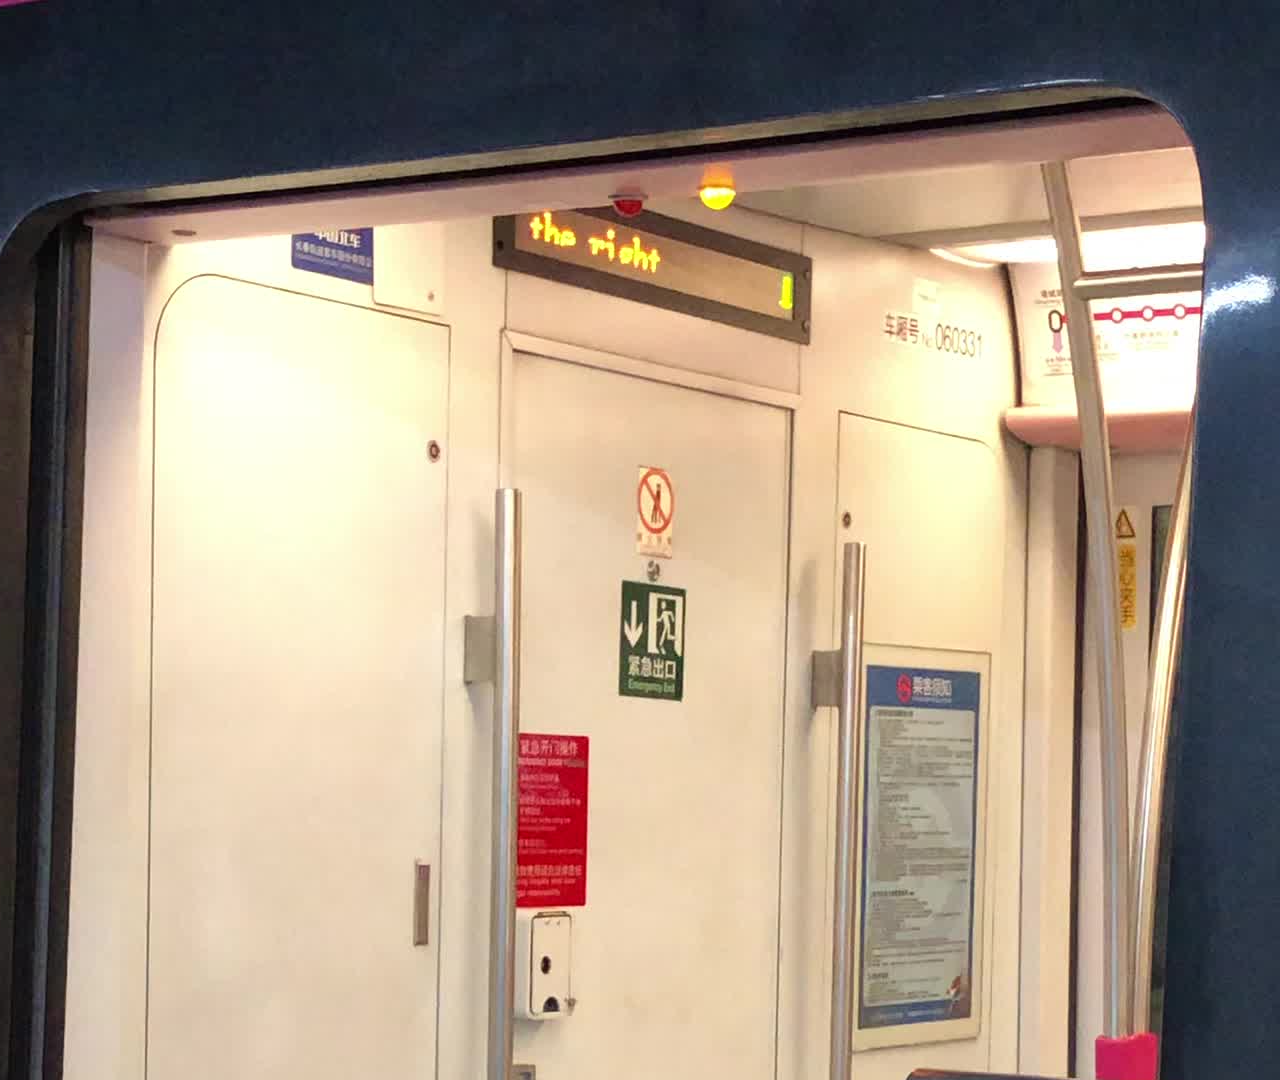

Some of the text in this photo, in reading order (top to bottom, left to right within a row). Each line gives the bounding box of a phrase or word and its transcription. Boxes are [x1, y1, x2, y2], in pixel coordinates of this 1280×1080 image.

[530, 212, 660, 272] the right
[936, 323, 982, 358] 060331
